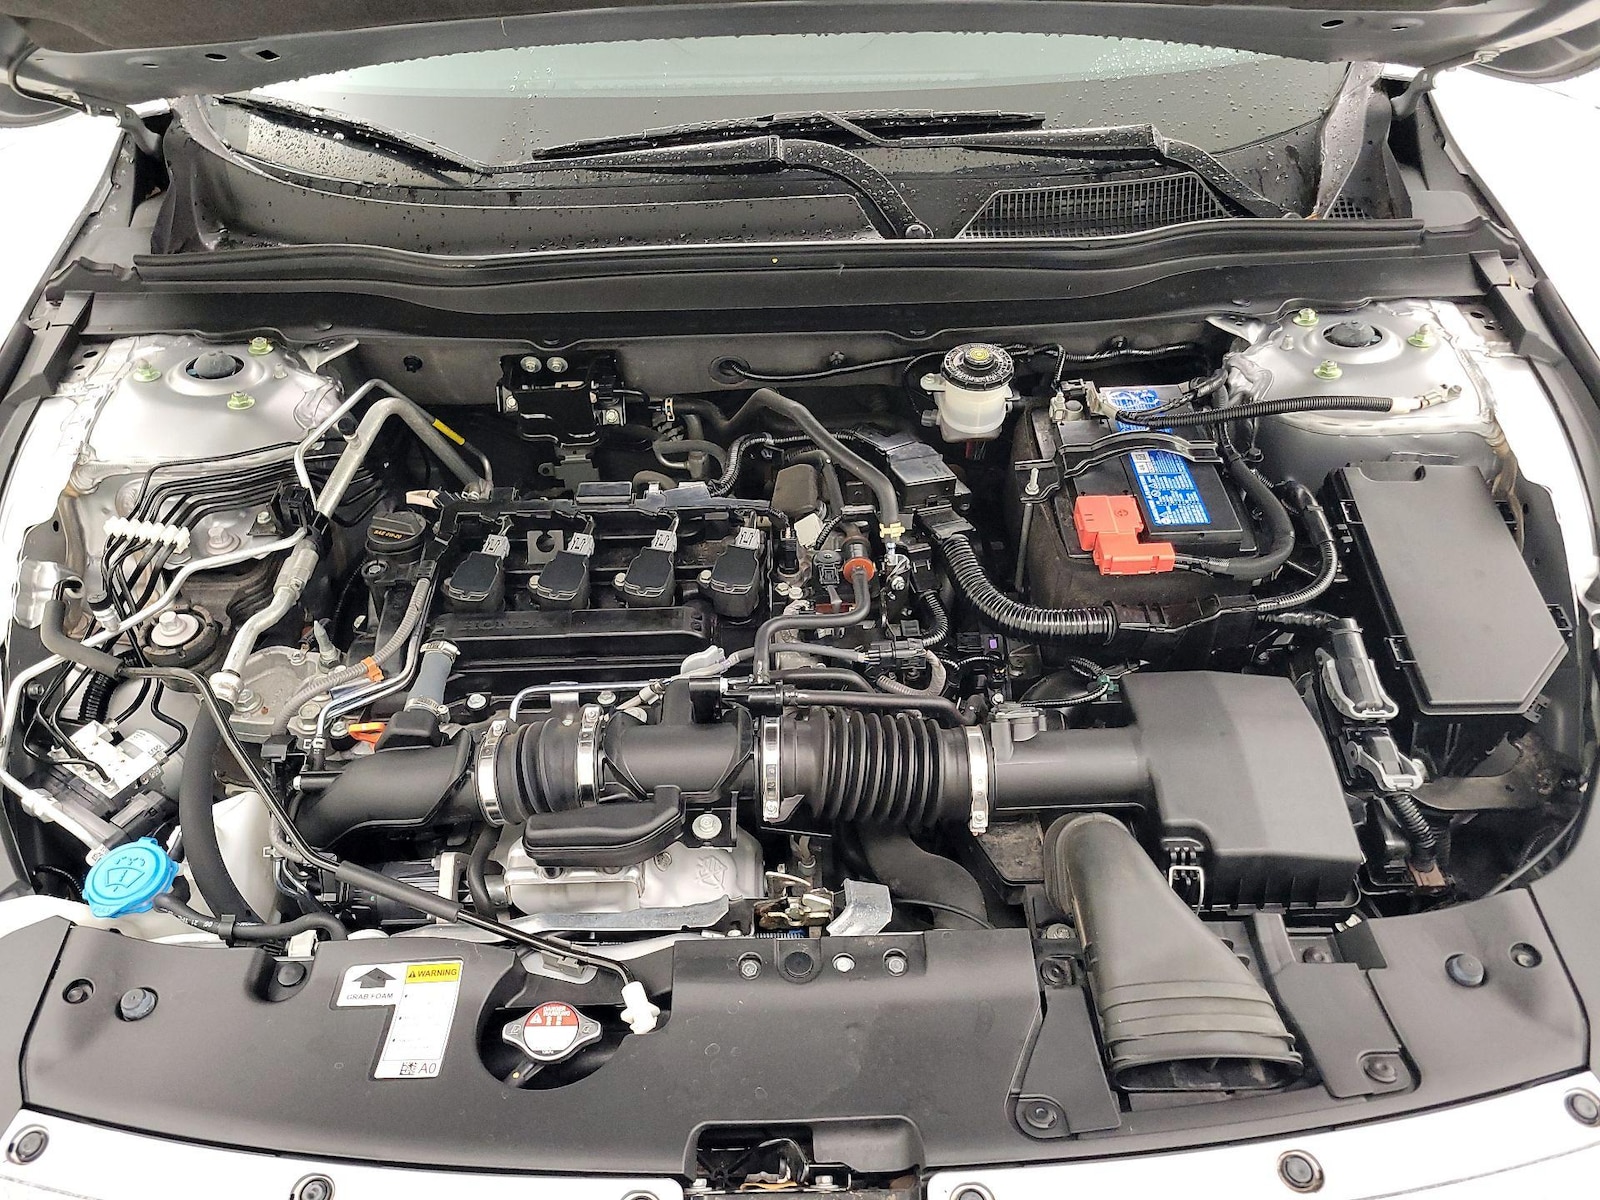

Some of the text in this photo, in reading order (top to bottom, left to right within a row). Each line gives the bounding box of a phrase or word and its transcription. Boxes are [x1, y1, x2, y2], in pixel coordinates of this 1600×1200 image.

[417, 968, 457, 978] WARNING
[370, 992, 393, 1000] FOAM
[418, 1062, 437, 1074] A0
